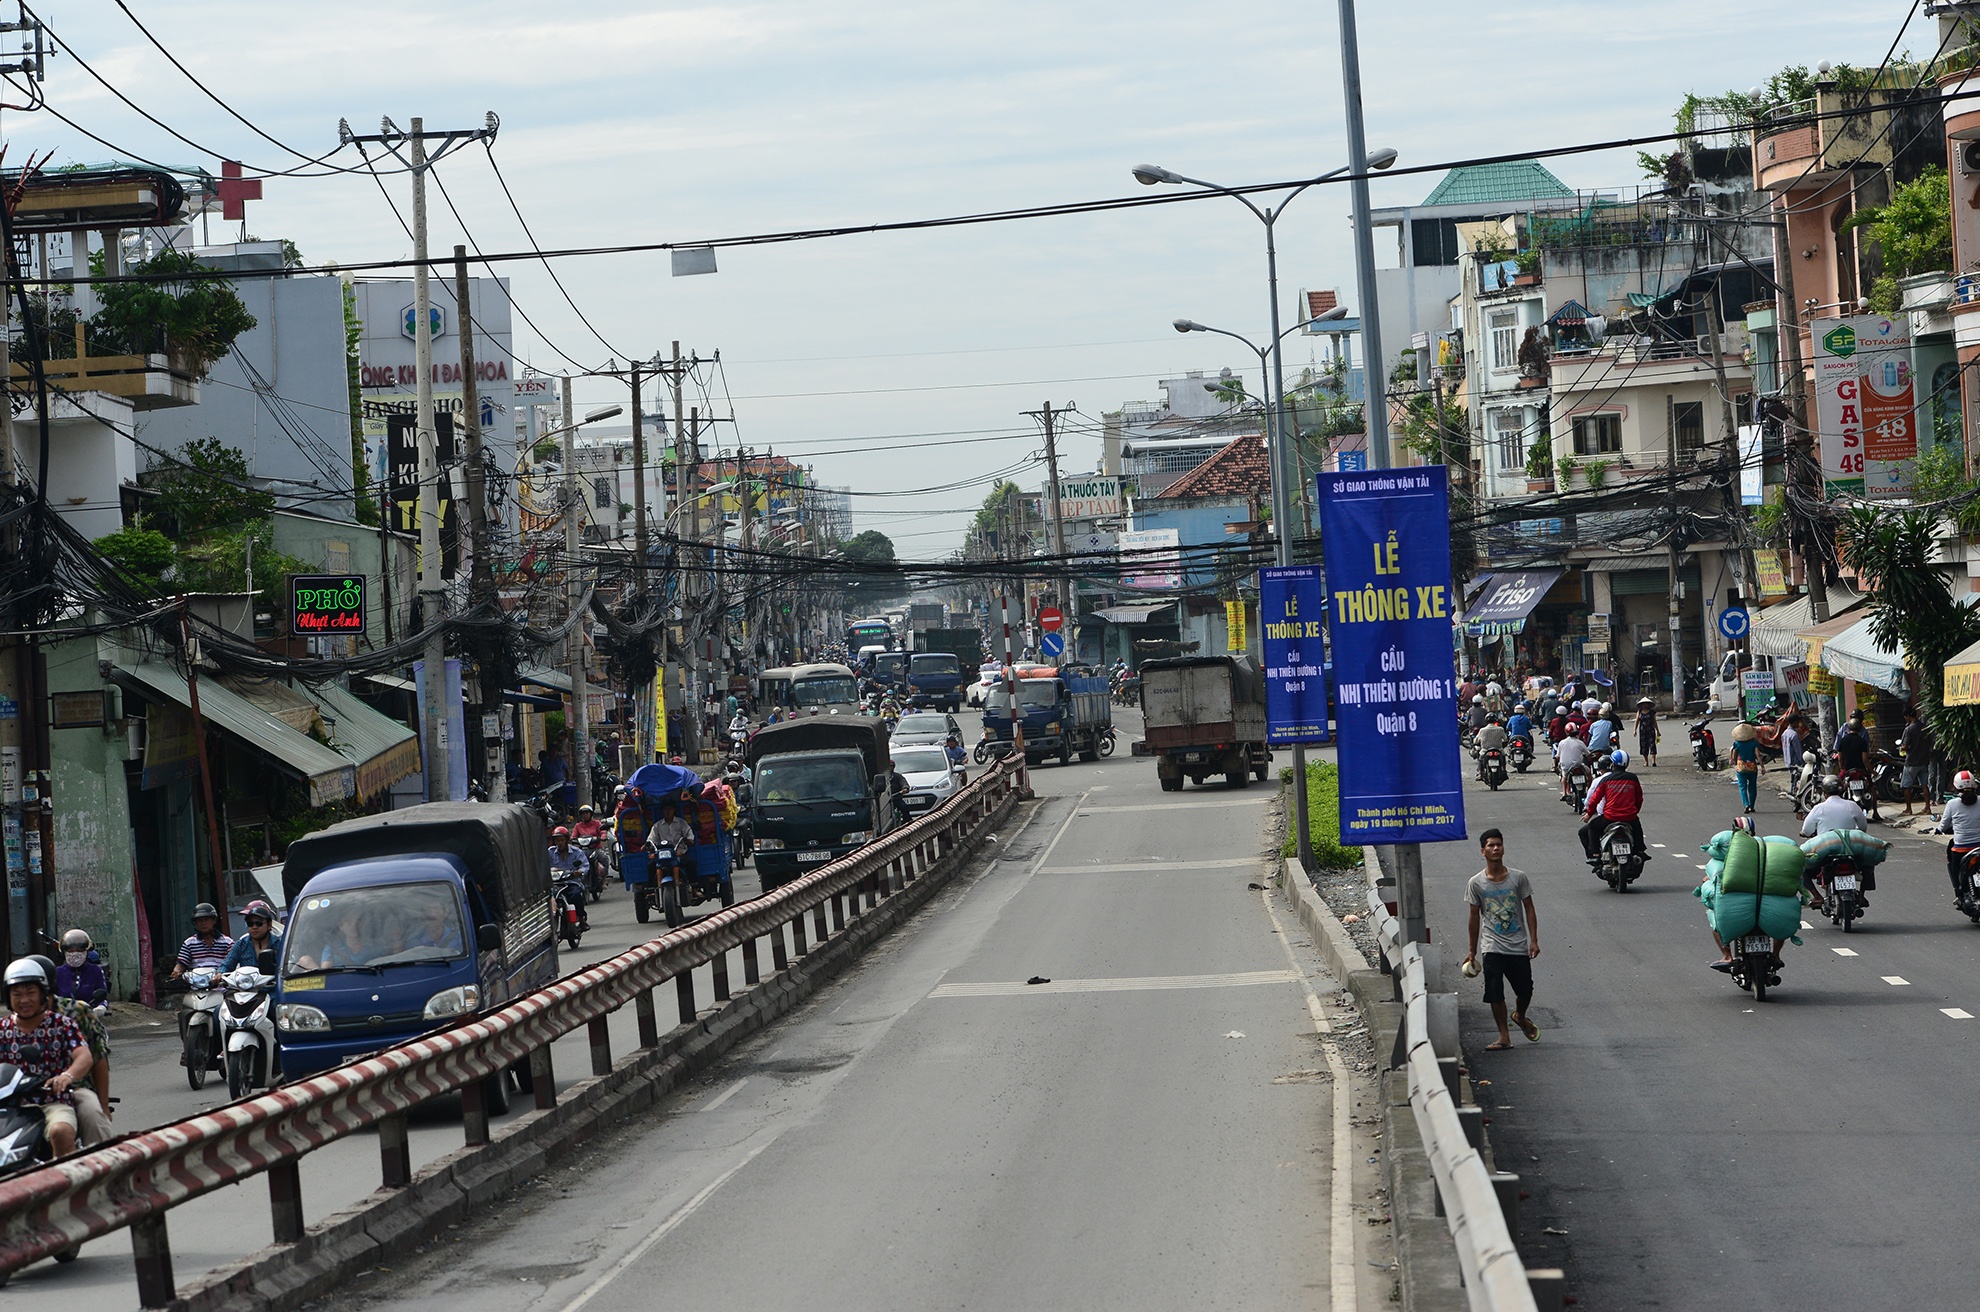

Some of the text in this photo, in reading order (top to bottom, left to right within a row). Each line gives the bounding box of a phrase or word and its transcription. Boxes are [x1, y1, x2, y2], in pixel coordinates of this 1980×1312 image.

[1875, 418, 1907, 438] 48
[1840, 453, 1864, 474] 48
[1067, 479, 1098, 498] THUỐC
[1100, 480, 1115, 496] TÂY
[1332, 474, 1429, 493] SỞ GIAO THÔNG VẬN TẢI
[1086, 498, 1117, 515] TÂM
[1373, 530, 1400, 575] LỄ
[296, 579, 361, 610] PHỞ
[1335, 583, 1446, 623] THÔNG XE
[1487, 583, 1536, 605] Friso
[1285, 594, 1298, 616] LỄ
[330, 611, 360, 627] Anh
[1265, 619, 1320, 639] THÔNG XE
[1380, 644, 1405, 671] CẦU
[1267, 668, 1278, 680] NHỊ
[1279, 665, 1296, 678] THIÊN
[1317, 666, 1322, 675] 1
[1285, 681, 1305, 693] Quận 8
[1339, 675, 1451, 708] NHỊ THIÊN ĐƯỜNG 1
[1376, 711, 1417, 737] Quận 8
[1357, 808, 1380, 817] Thành
[1382, 806, 1396, 817] phố
[1410, 806, 1423, 815] Chí
[1350, 815, 1455, 829] ngày 19 tháng 10 năm 2017
